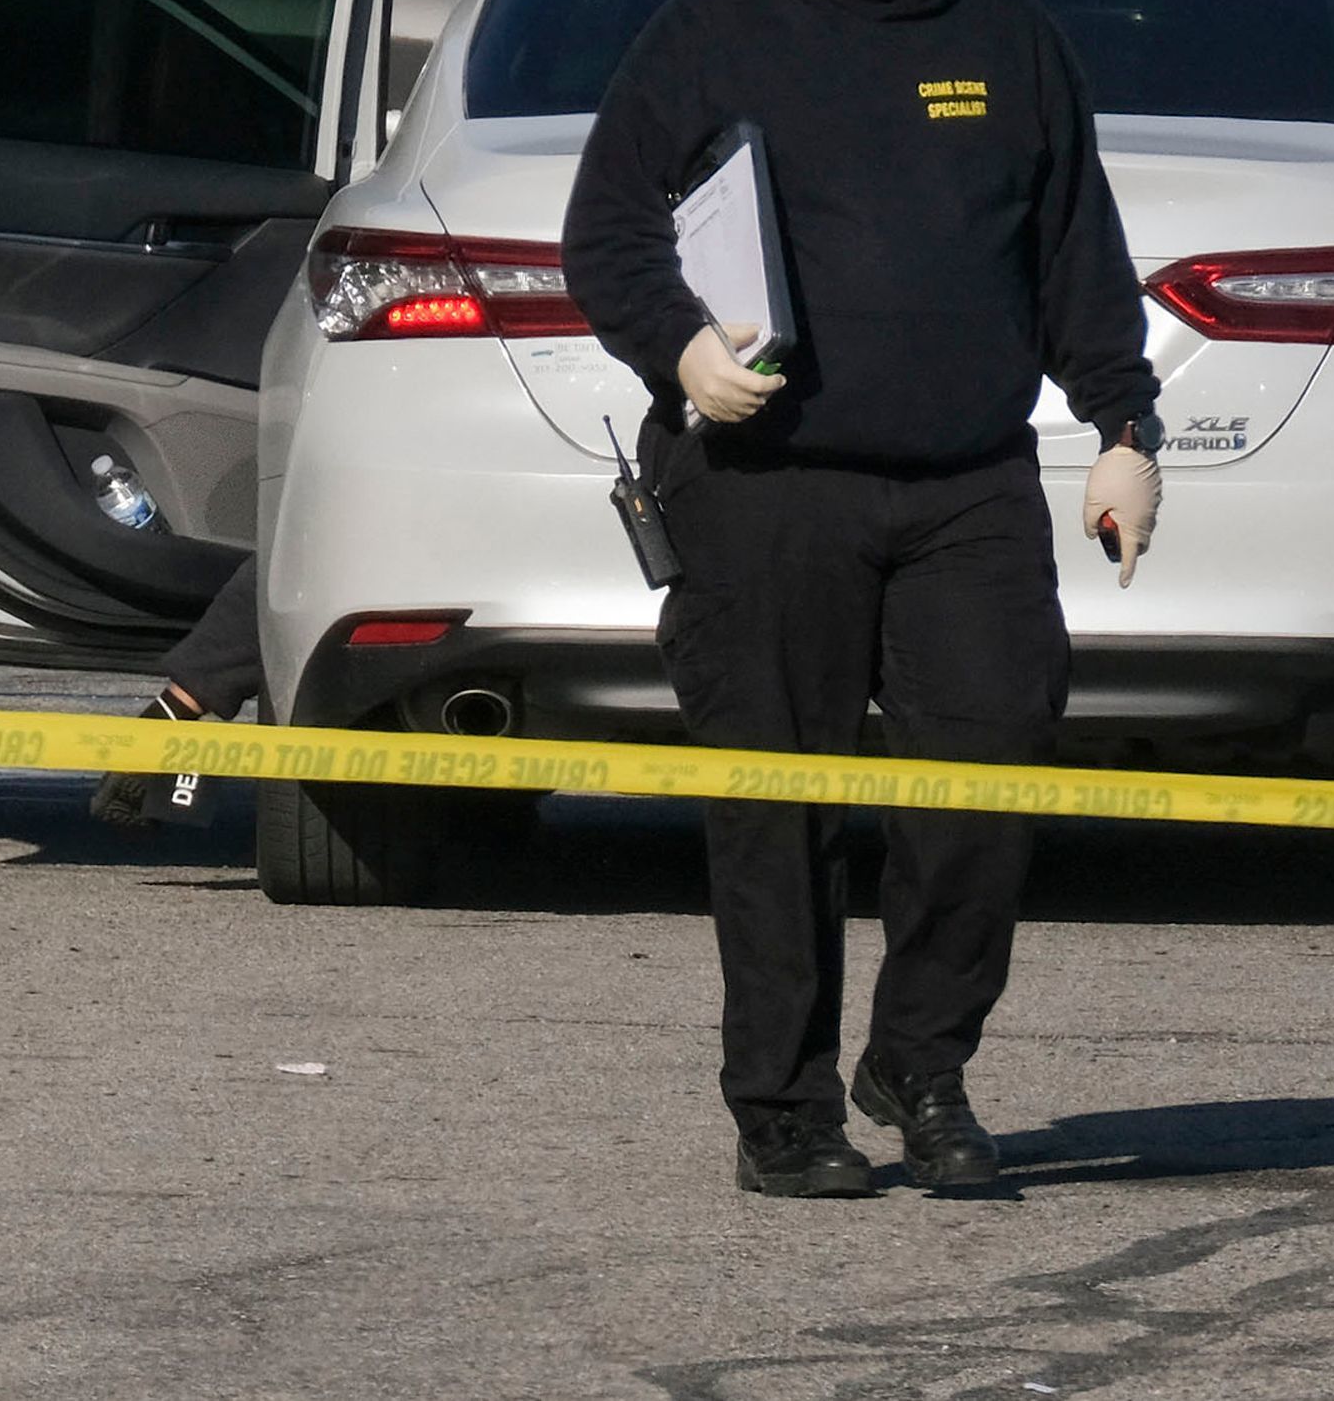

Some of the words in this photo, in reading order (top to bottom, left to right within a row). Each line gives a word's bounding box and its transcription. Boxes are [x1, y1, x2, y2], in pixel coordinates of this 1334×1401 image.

[918, 81, 954, 97] CRIME
[954, 80, 988, 96] SCENE
[927, 101, 987, 118] SPECIALIST
[1184, 416, 1249, 431] XLE
[1164, 437, 1230, 451] YBRID
[172, 771, 198, 806] DE
